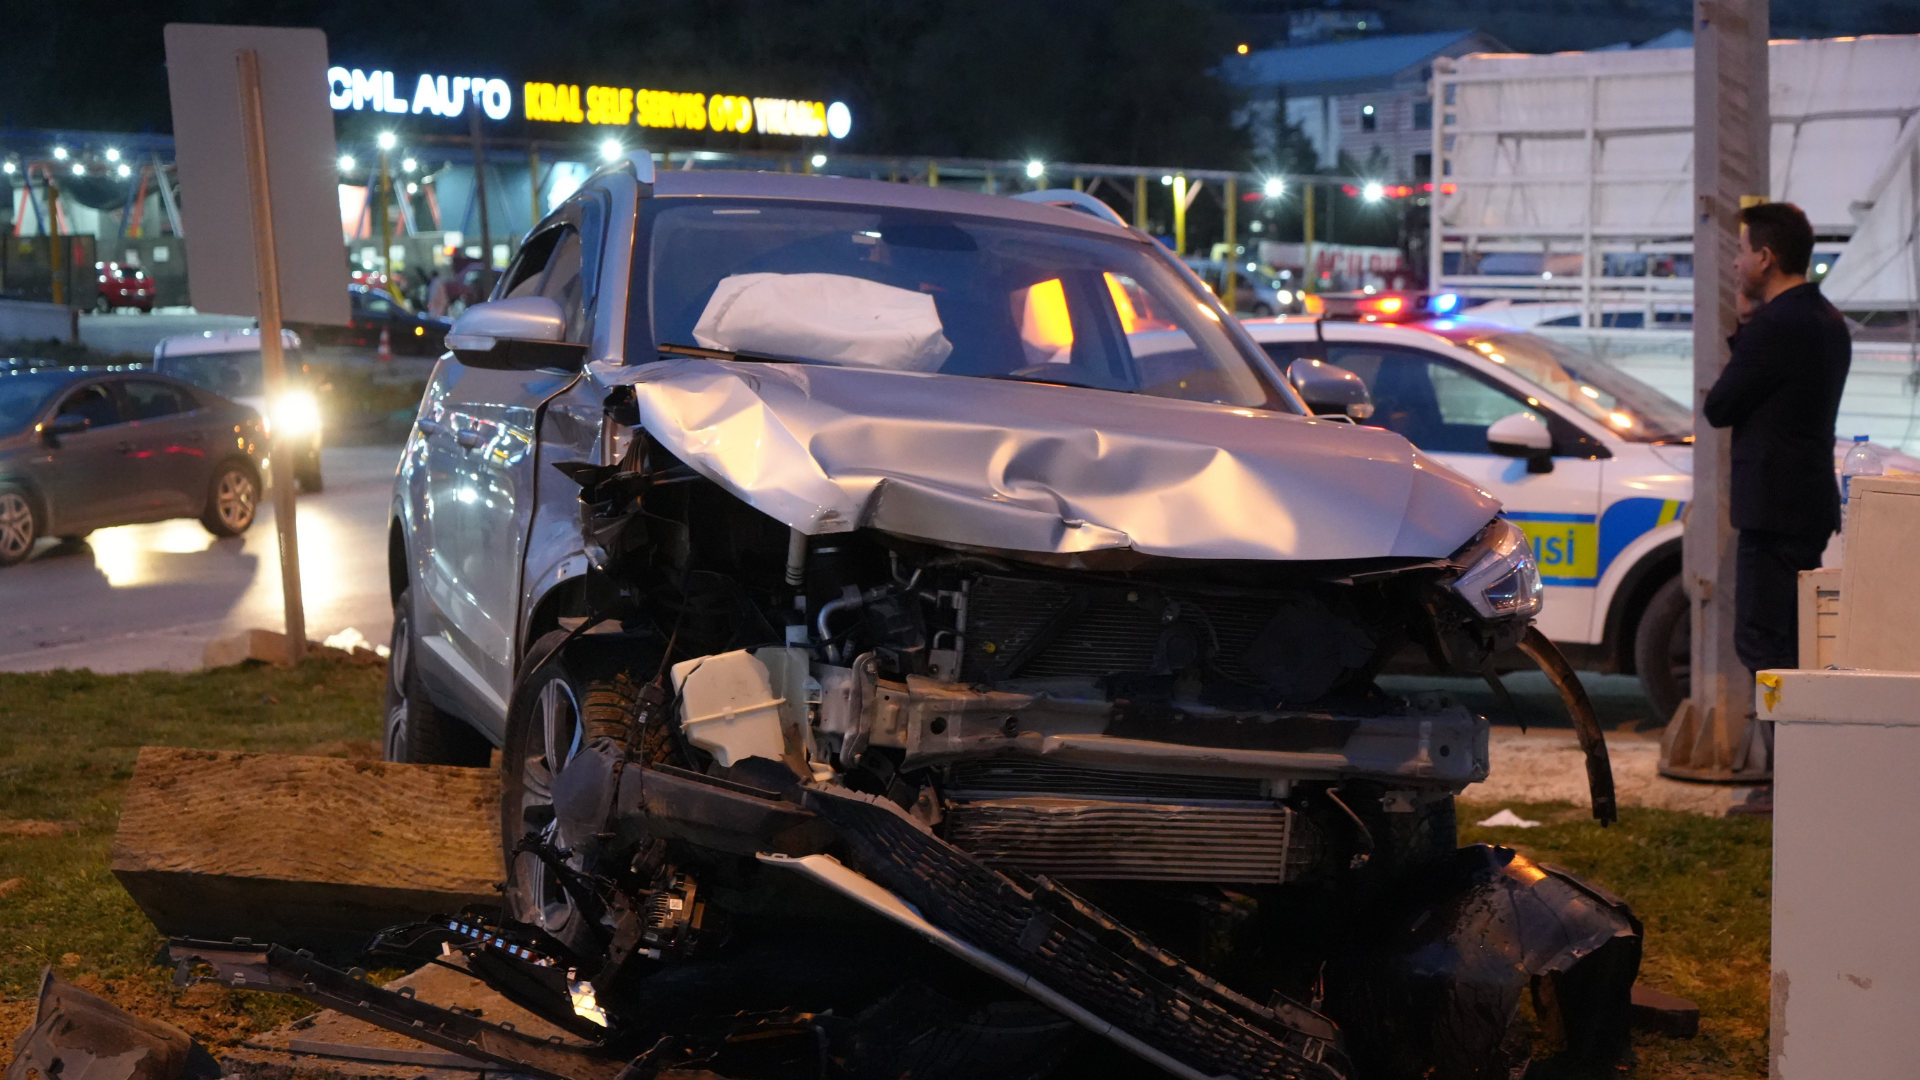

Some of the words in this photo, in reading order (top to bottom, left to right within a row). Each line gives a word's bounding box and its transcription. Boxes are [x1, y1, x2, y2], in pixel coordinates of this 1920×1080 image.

[328, 67, 408, 113] CML
[525, 82, 584, 123] KRAL
[586, 86, 633, 125] SELF
[708, 94, 753, 134] OTO
